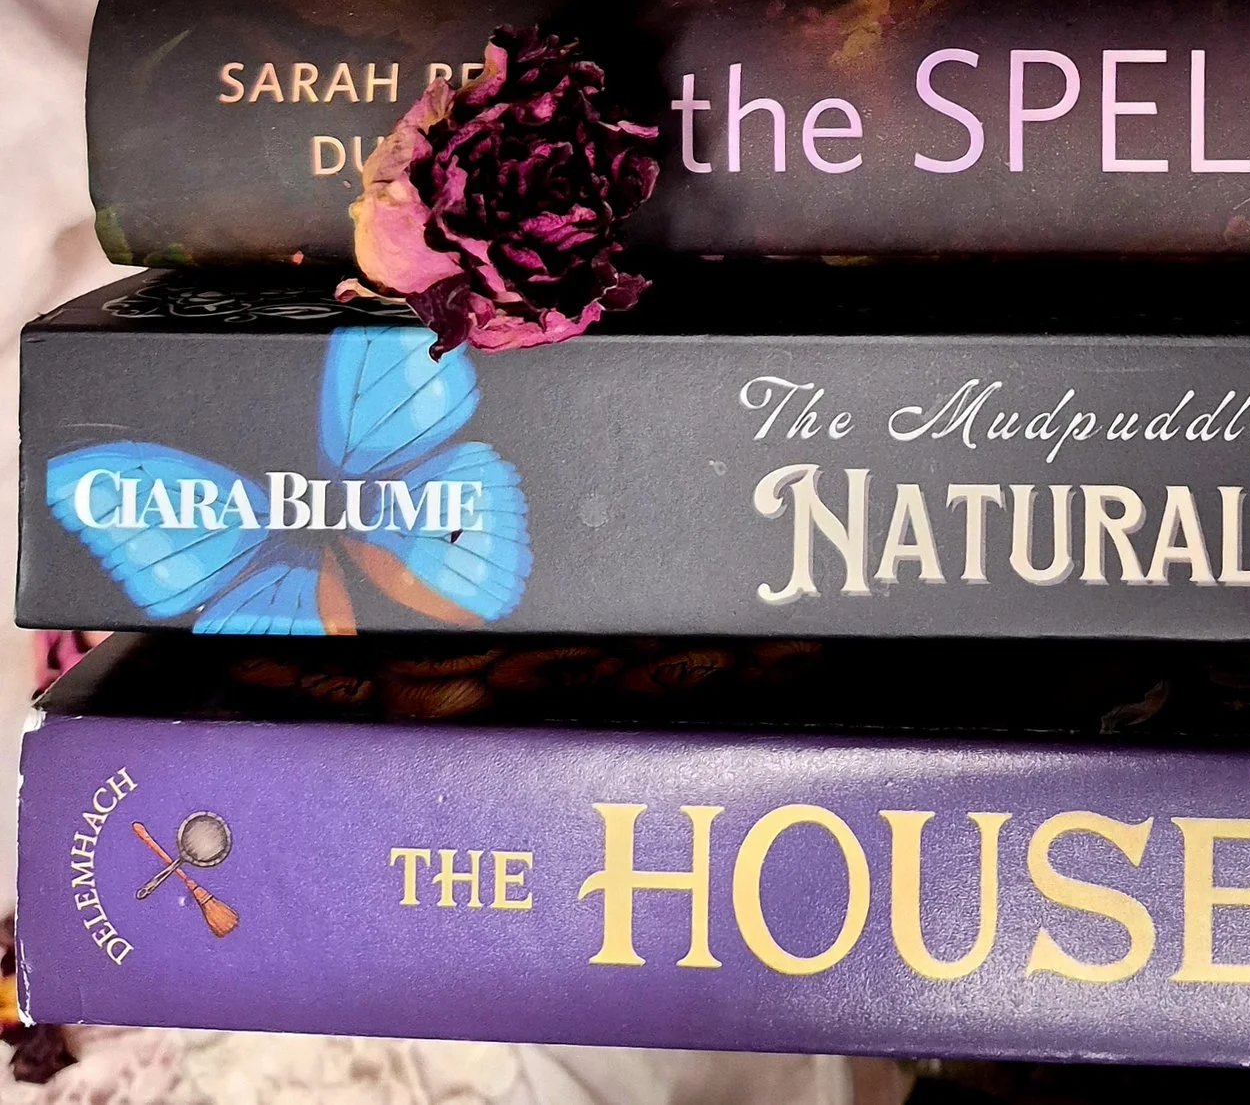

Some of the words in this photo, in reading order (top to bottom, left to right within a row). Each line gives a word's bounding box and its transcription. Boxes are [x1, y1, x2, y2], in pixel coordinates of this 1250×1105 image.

[219, 61, 399, 103] SARAH
[671, 62, 864, 175] the
[739, 376, 854, 441] The
[74, 468, 270, 531] CIARA
[265, 471, 483, 533] BLUME
[70, 766, 139, 966] DELEMHACH
[389, 847, 535, 910] THE
